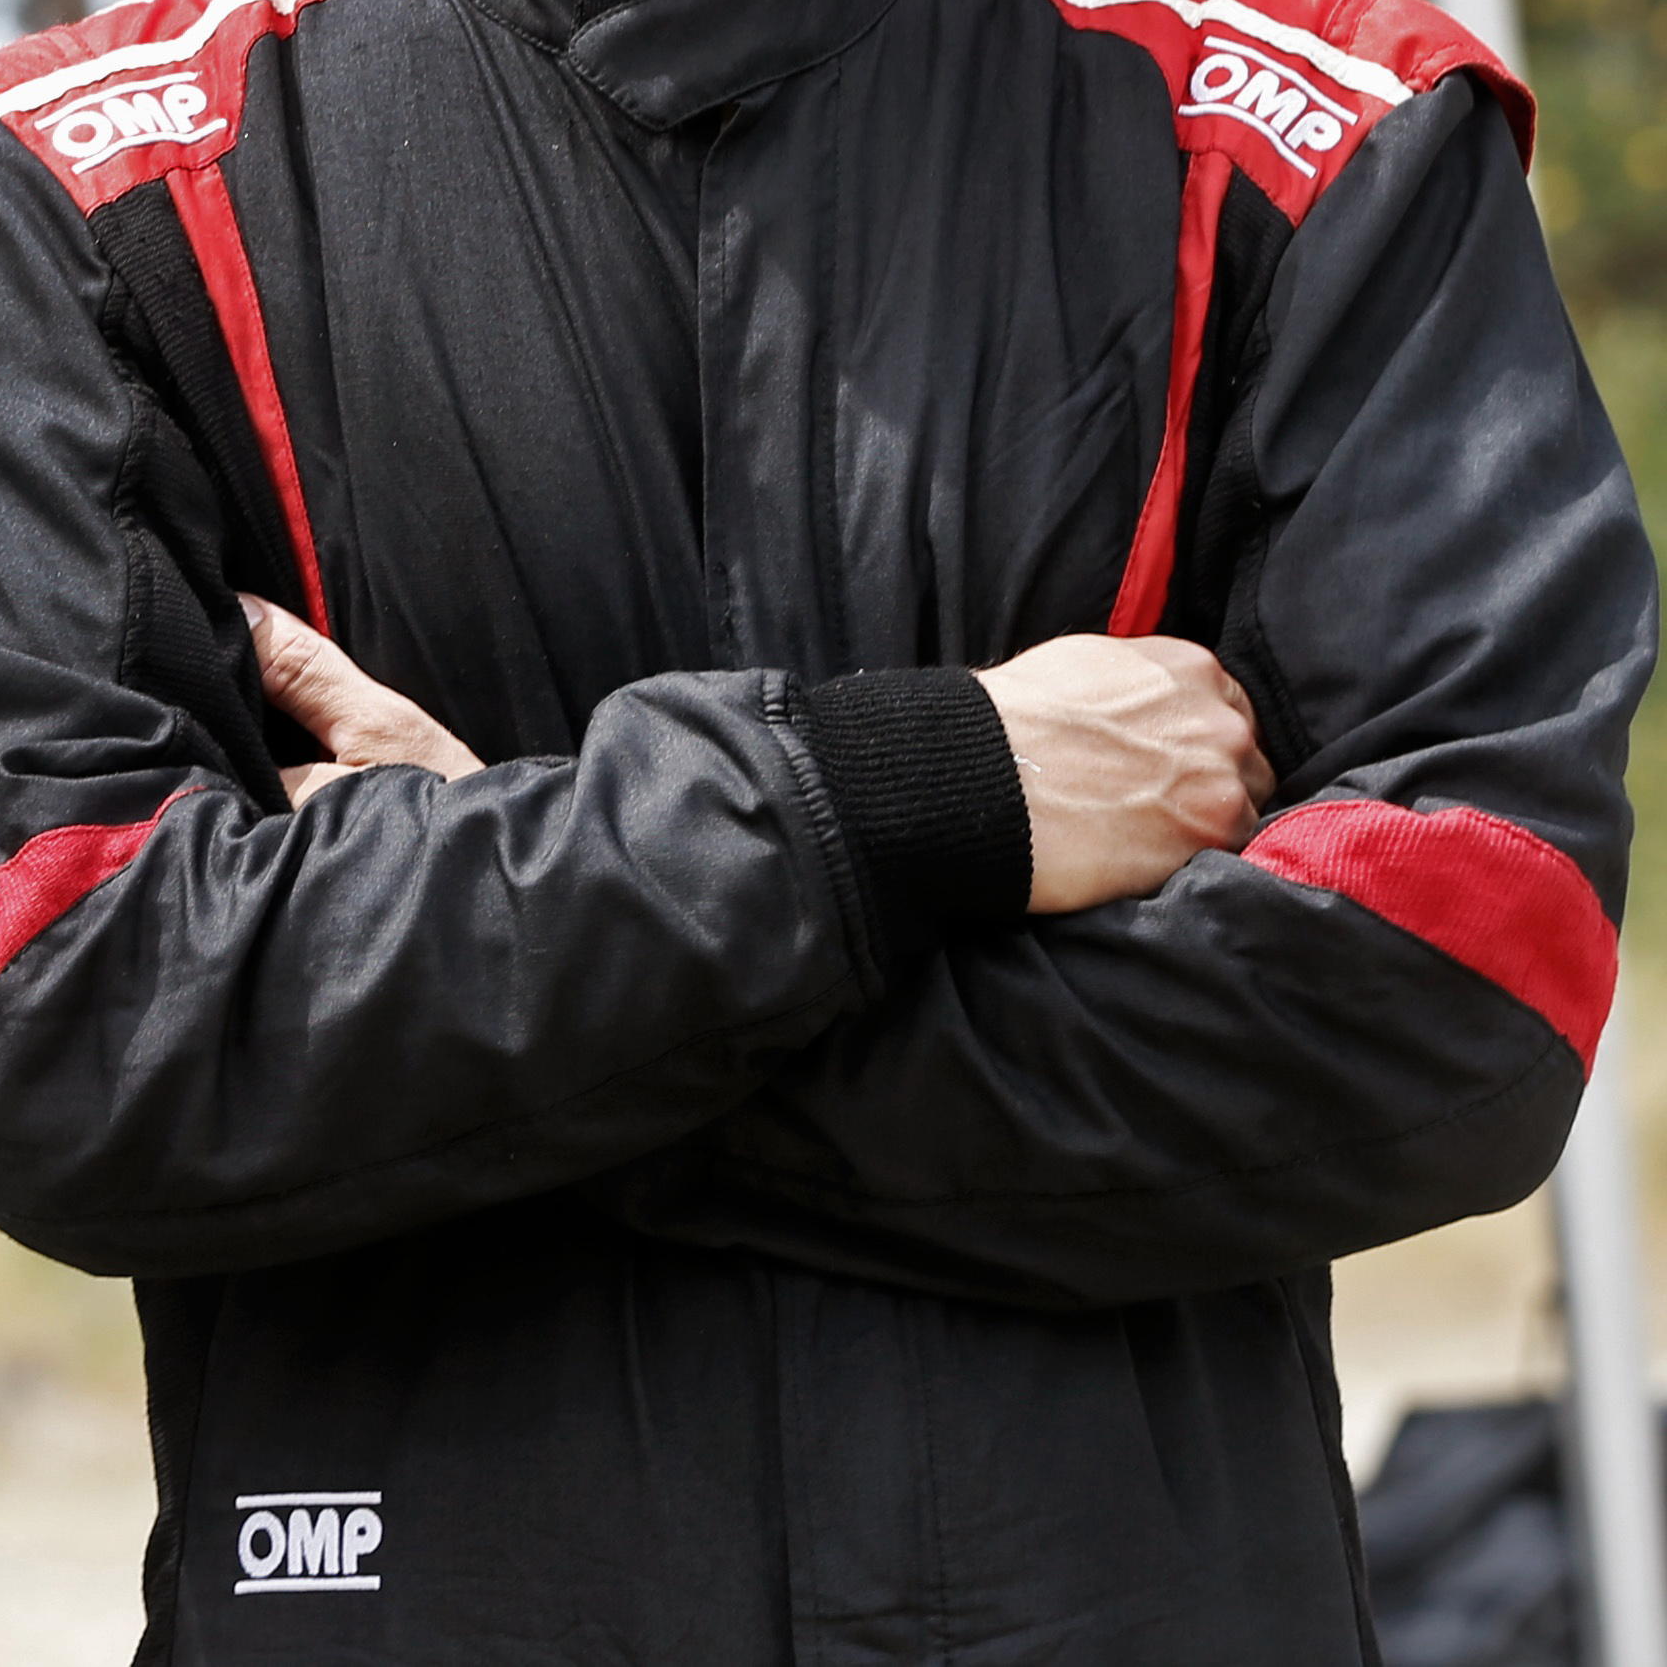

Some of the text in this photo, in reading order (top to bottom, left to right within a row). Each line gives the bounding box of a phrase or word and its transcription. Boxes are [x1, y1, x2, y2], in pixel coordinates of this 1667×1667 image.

[52, 84, 207, 157] OMP
[1190, 54, 1342, 153] OMP
[238, 1508, 382, 1578] OMP
